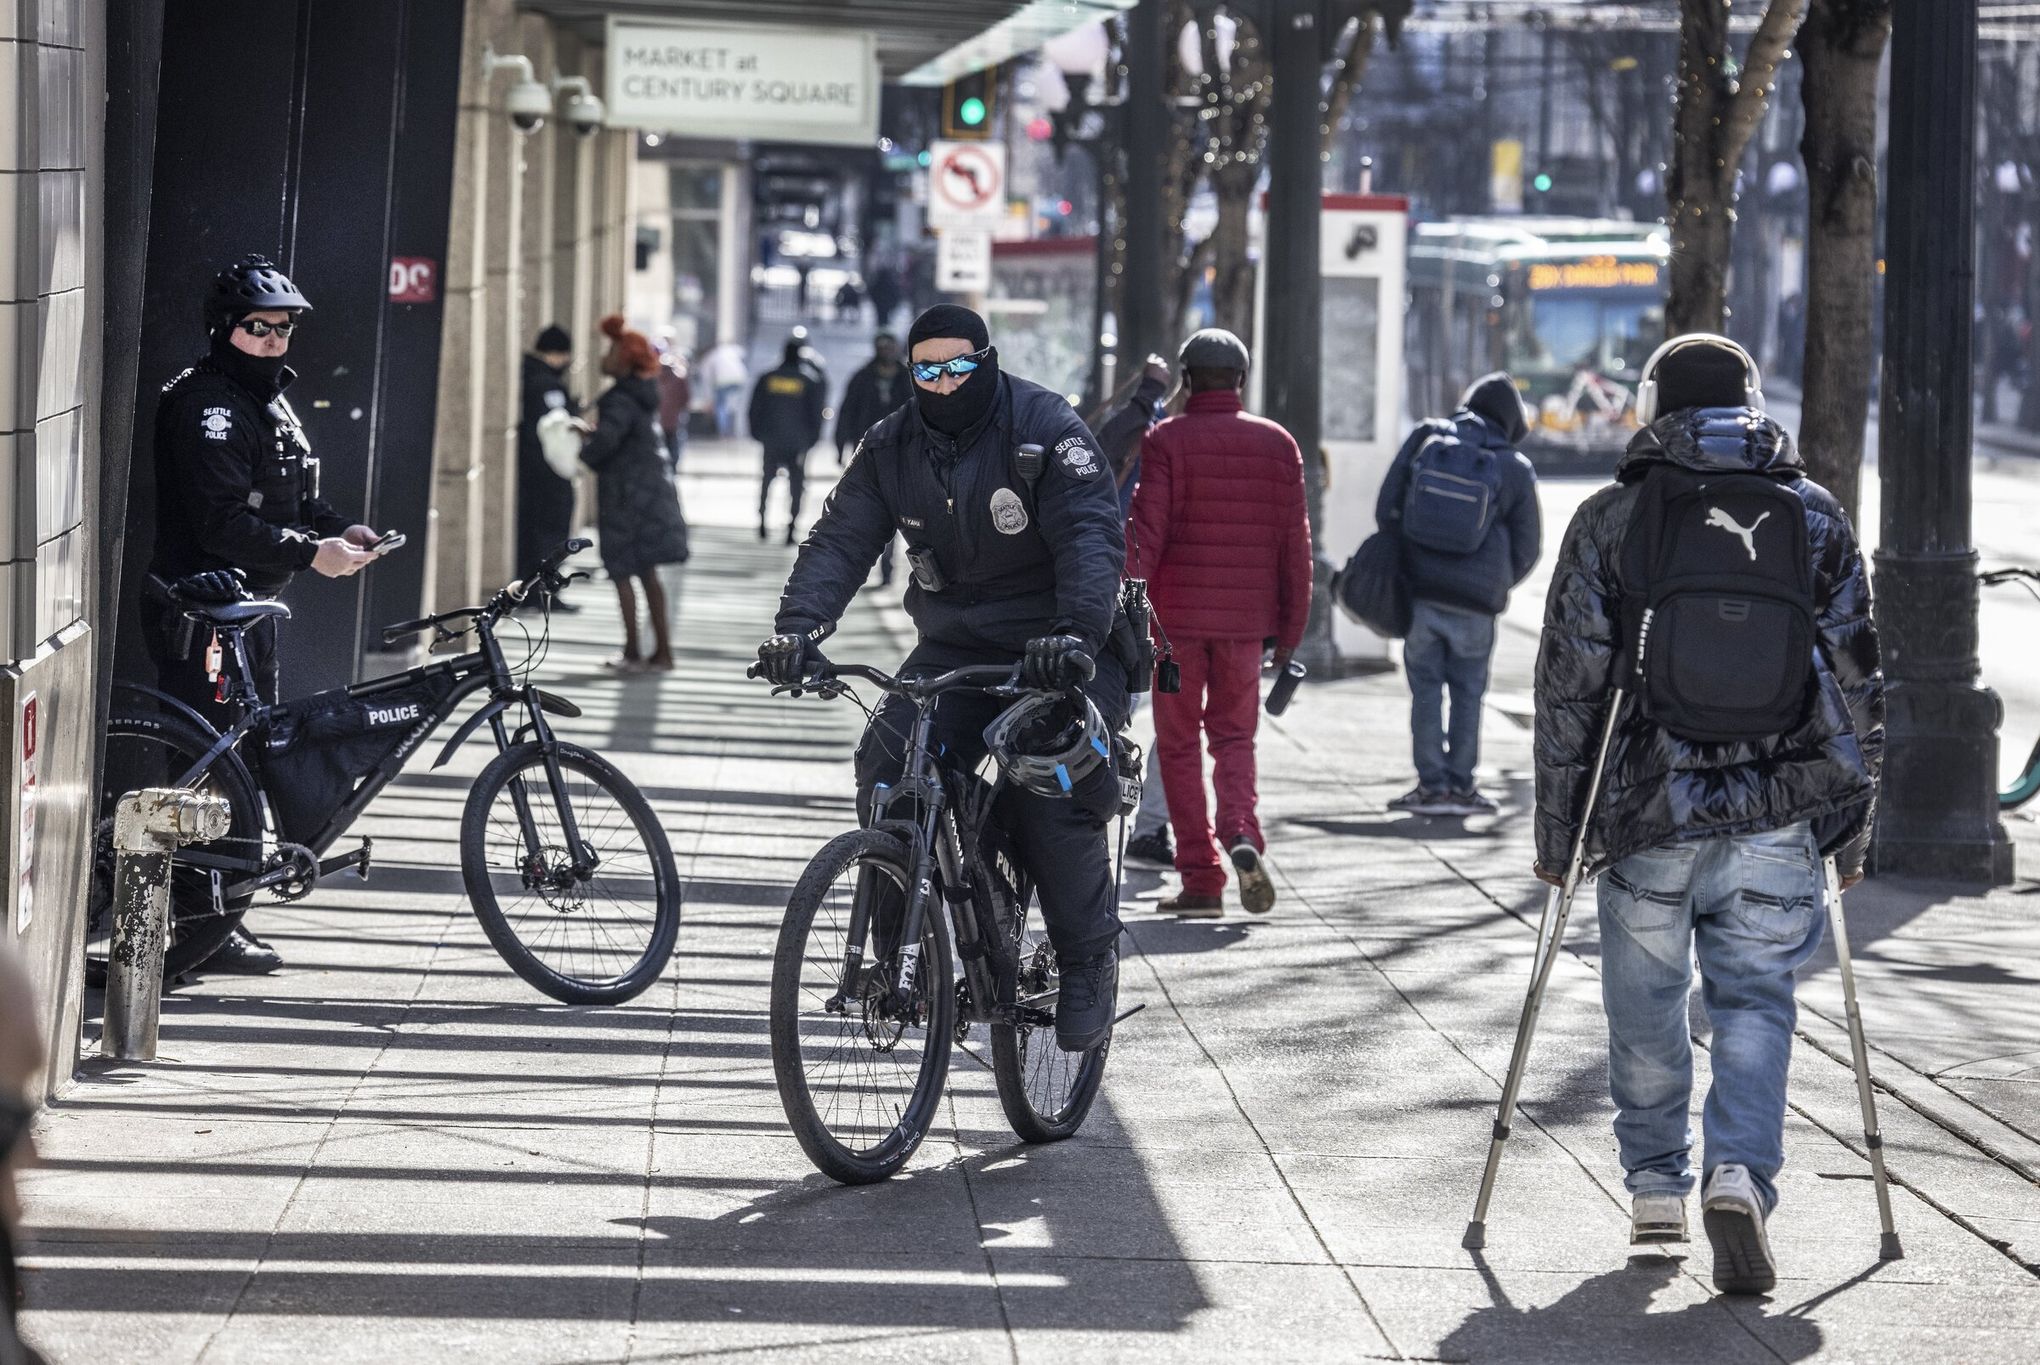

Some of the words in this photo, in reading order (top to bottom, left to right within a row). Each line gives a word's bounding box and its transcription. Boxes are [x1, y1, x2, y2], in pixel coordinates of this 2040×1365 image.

[623, 46, 730, 71] MARKET
[736, 54, 758, 72] at
[622, 75, 747, 102] CENTURY
[751, 79, 856, 106] SQUARE
[203, 406, 232, 417] SEATTLE
[205, 430, 228, 441] POLICE
[1055, 436, 1086, 454] SEATTLE
[1075, 462, 1099, 477] POLICE
[807, 624, 825, 641] FOX
[368, 704, 419, 725] POLICE
[898, 954, 917, 991] FOX
